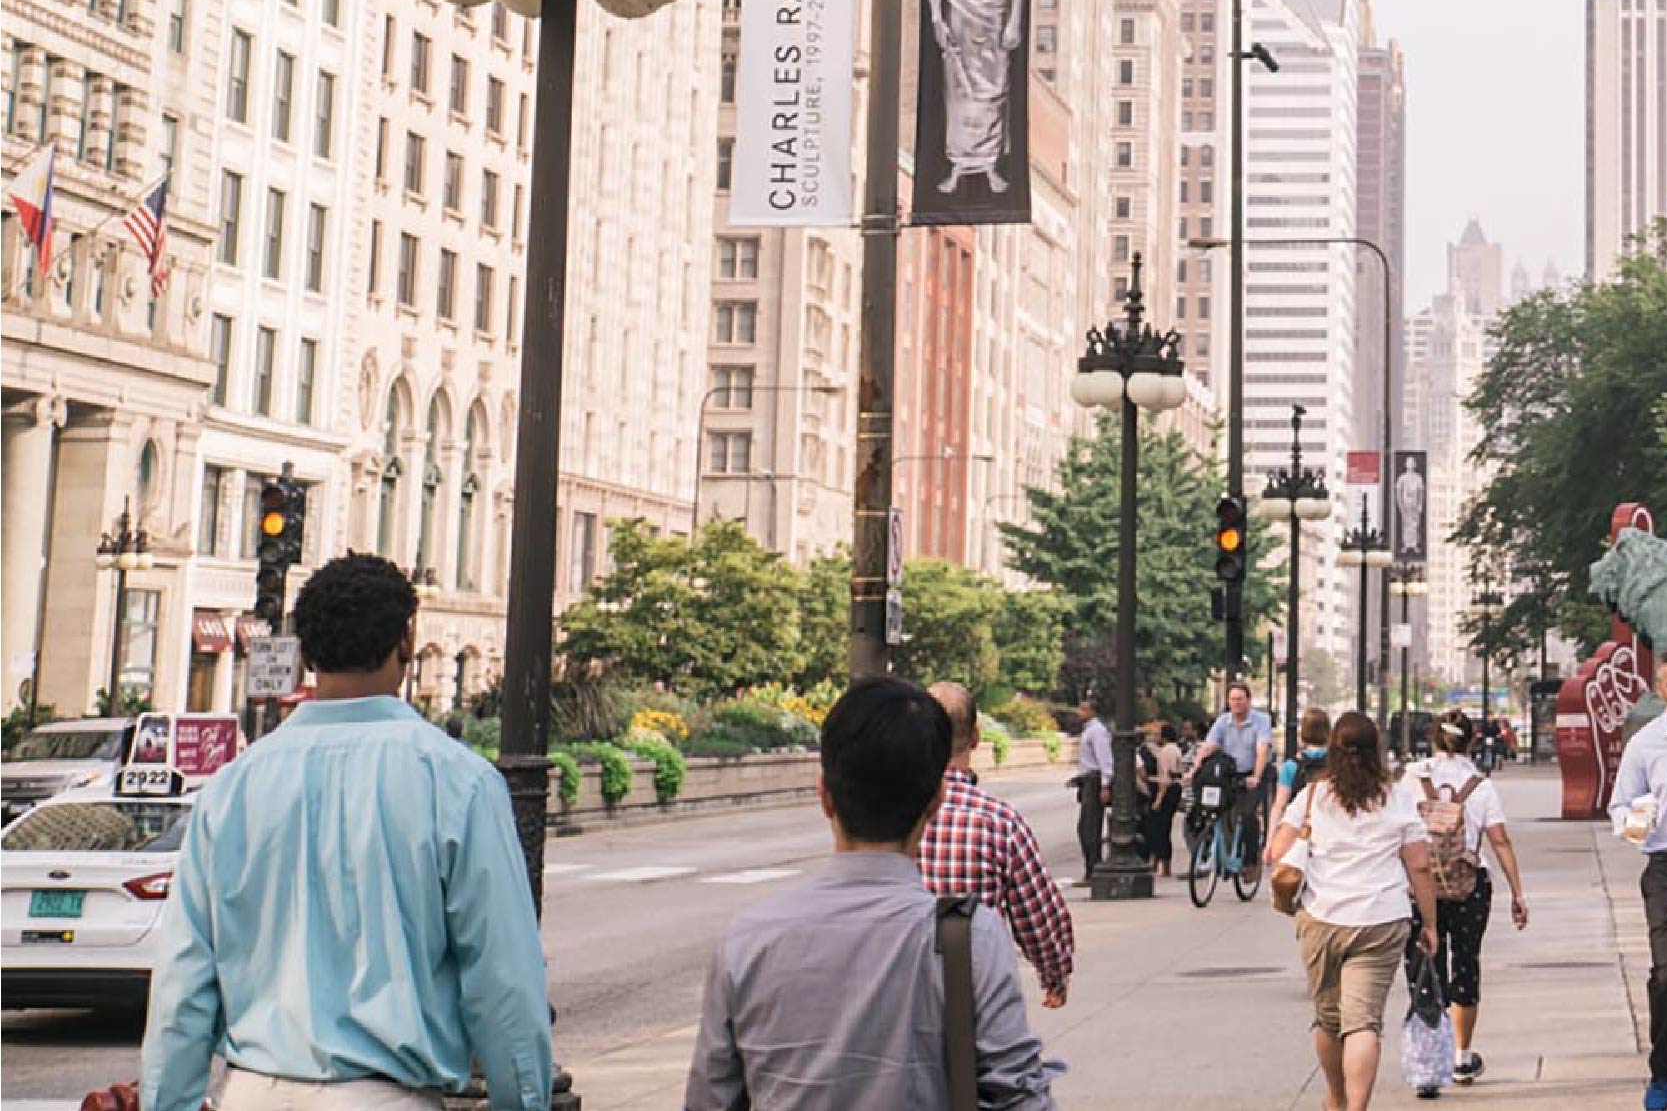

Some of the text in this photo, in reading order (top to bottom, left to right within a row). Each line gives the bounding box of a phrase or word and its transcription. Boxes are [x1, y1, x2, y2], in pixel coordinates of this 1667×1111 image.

[768, 44, 802, 210] CHARLES
[801, 77, 824, 207] SCULPTURE,
[126, 771, 168, 784] 2922
